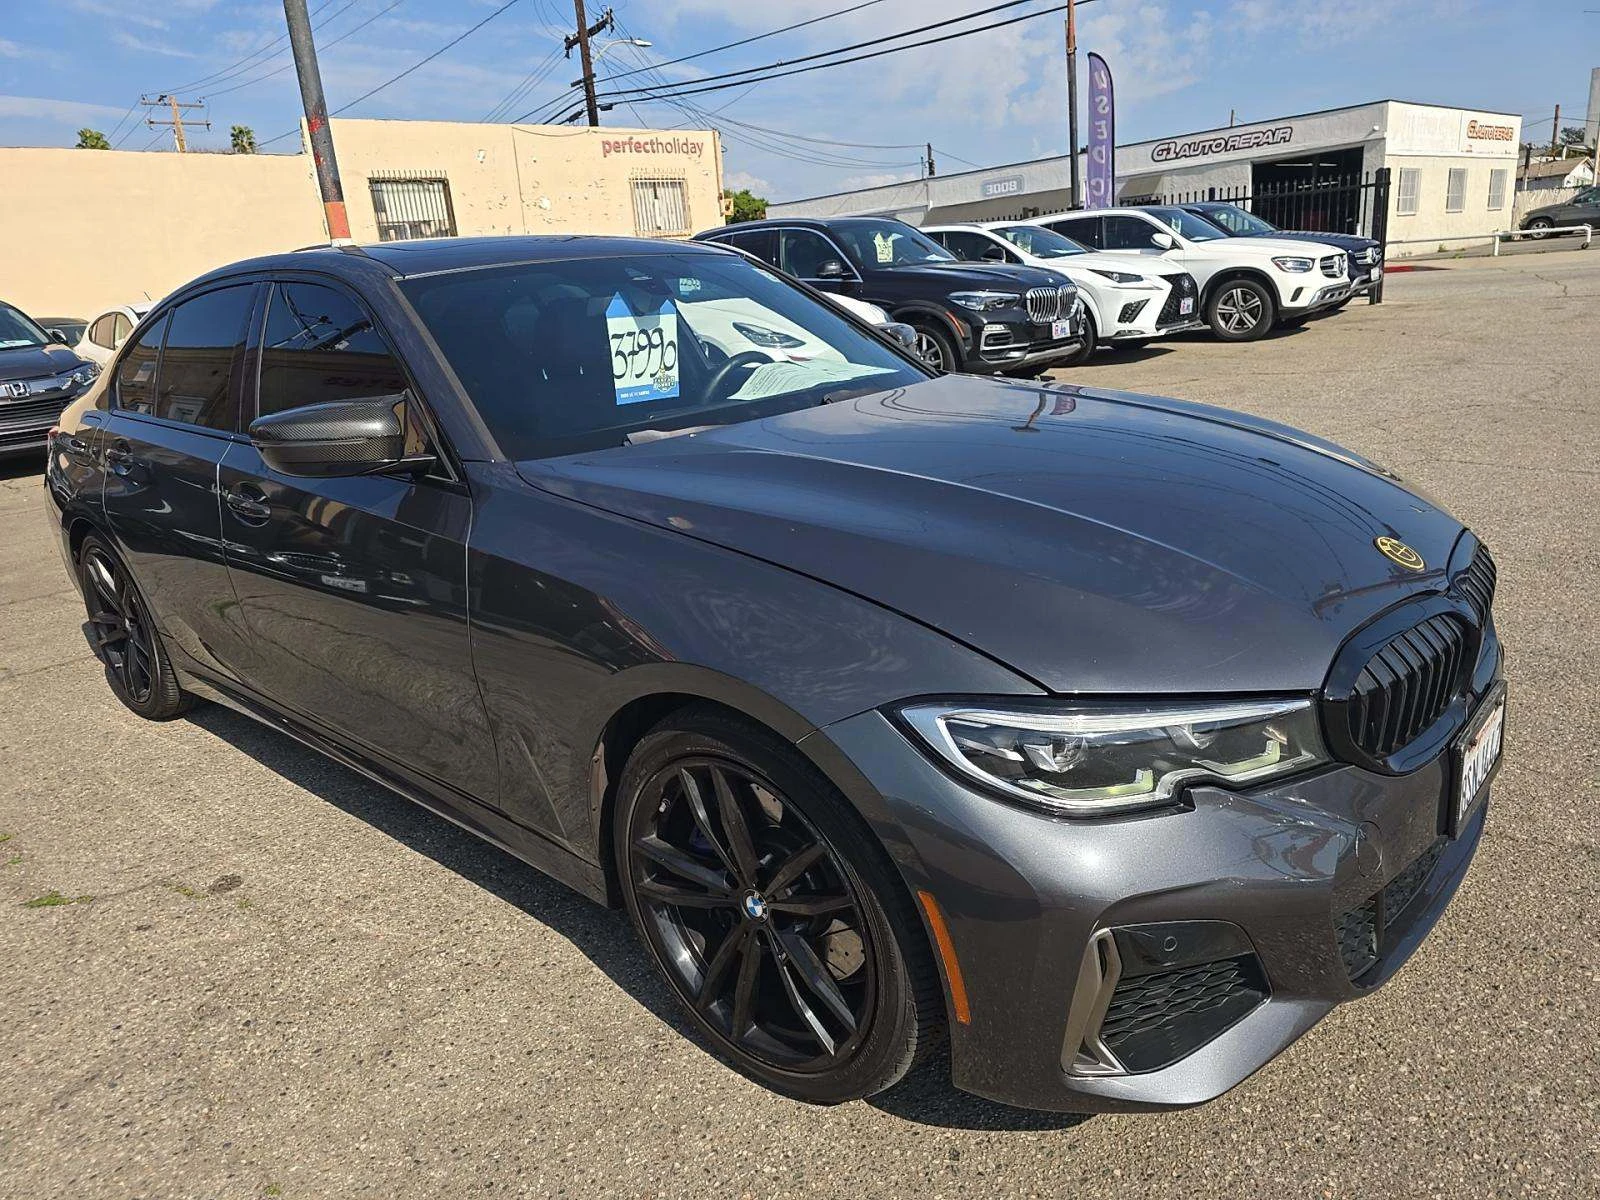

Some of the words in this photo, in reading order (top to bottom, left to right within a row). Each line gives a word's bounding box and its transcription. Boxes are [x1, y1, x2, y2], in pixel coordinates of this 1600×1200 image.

[601, 136, 705, 158] perfectholiday
[1175, 137, 1226, 159] AUTO
[1223, 127, 1293, 152] REPAIR
[986, 180, 1017, 194] 3008
[611, 327, 677, 380] 37990
